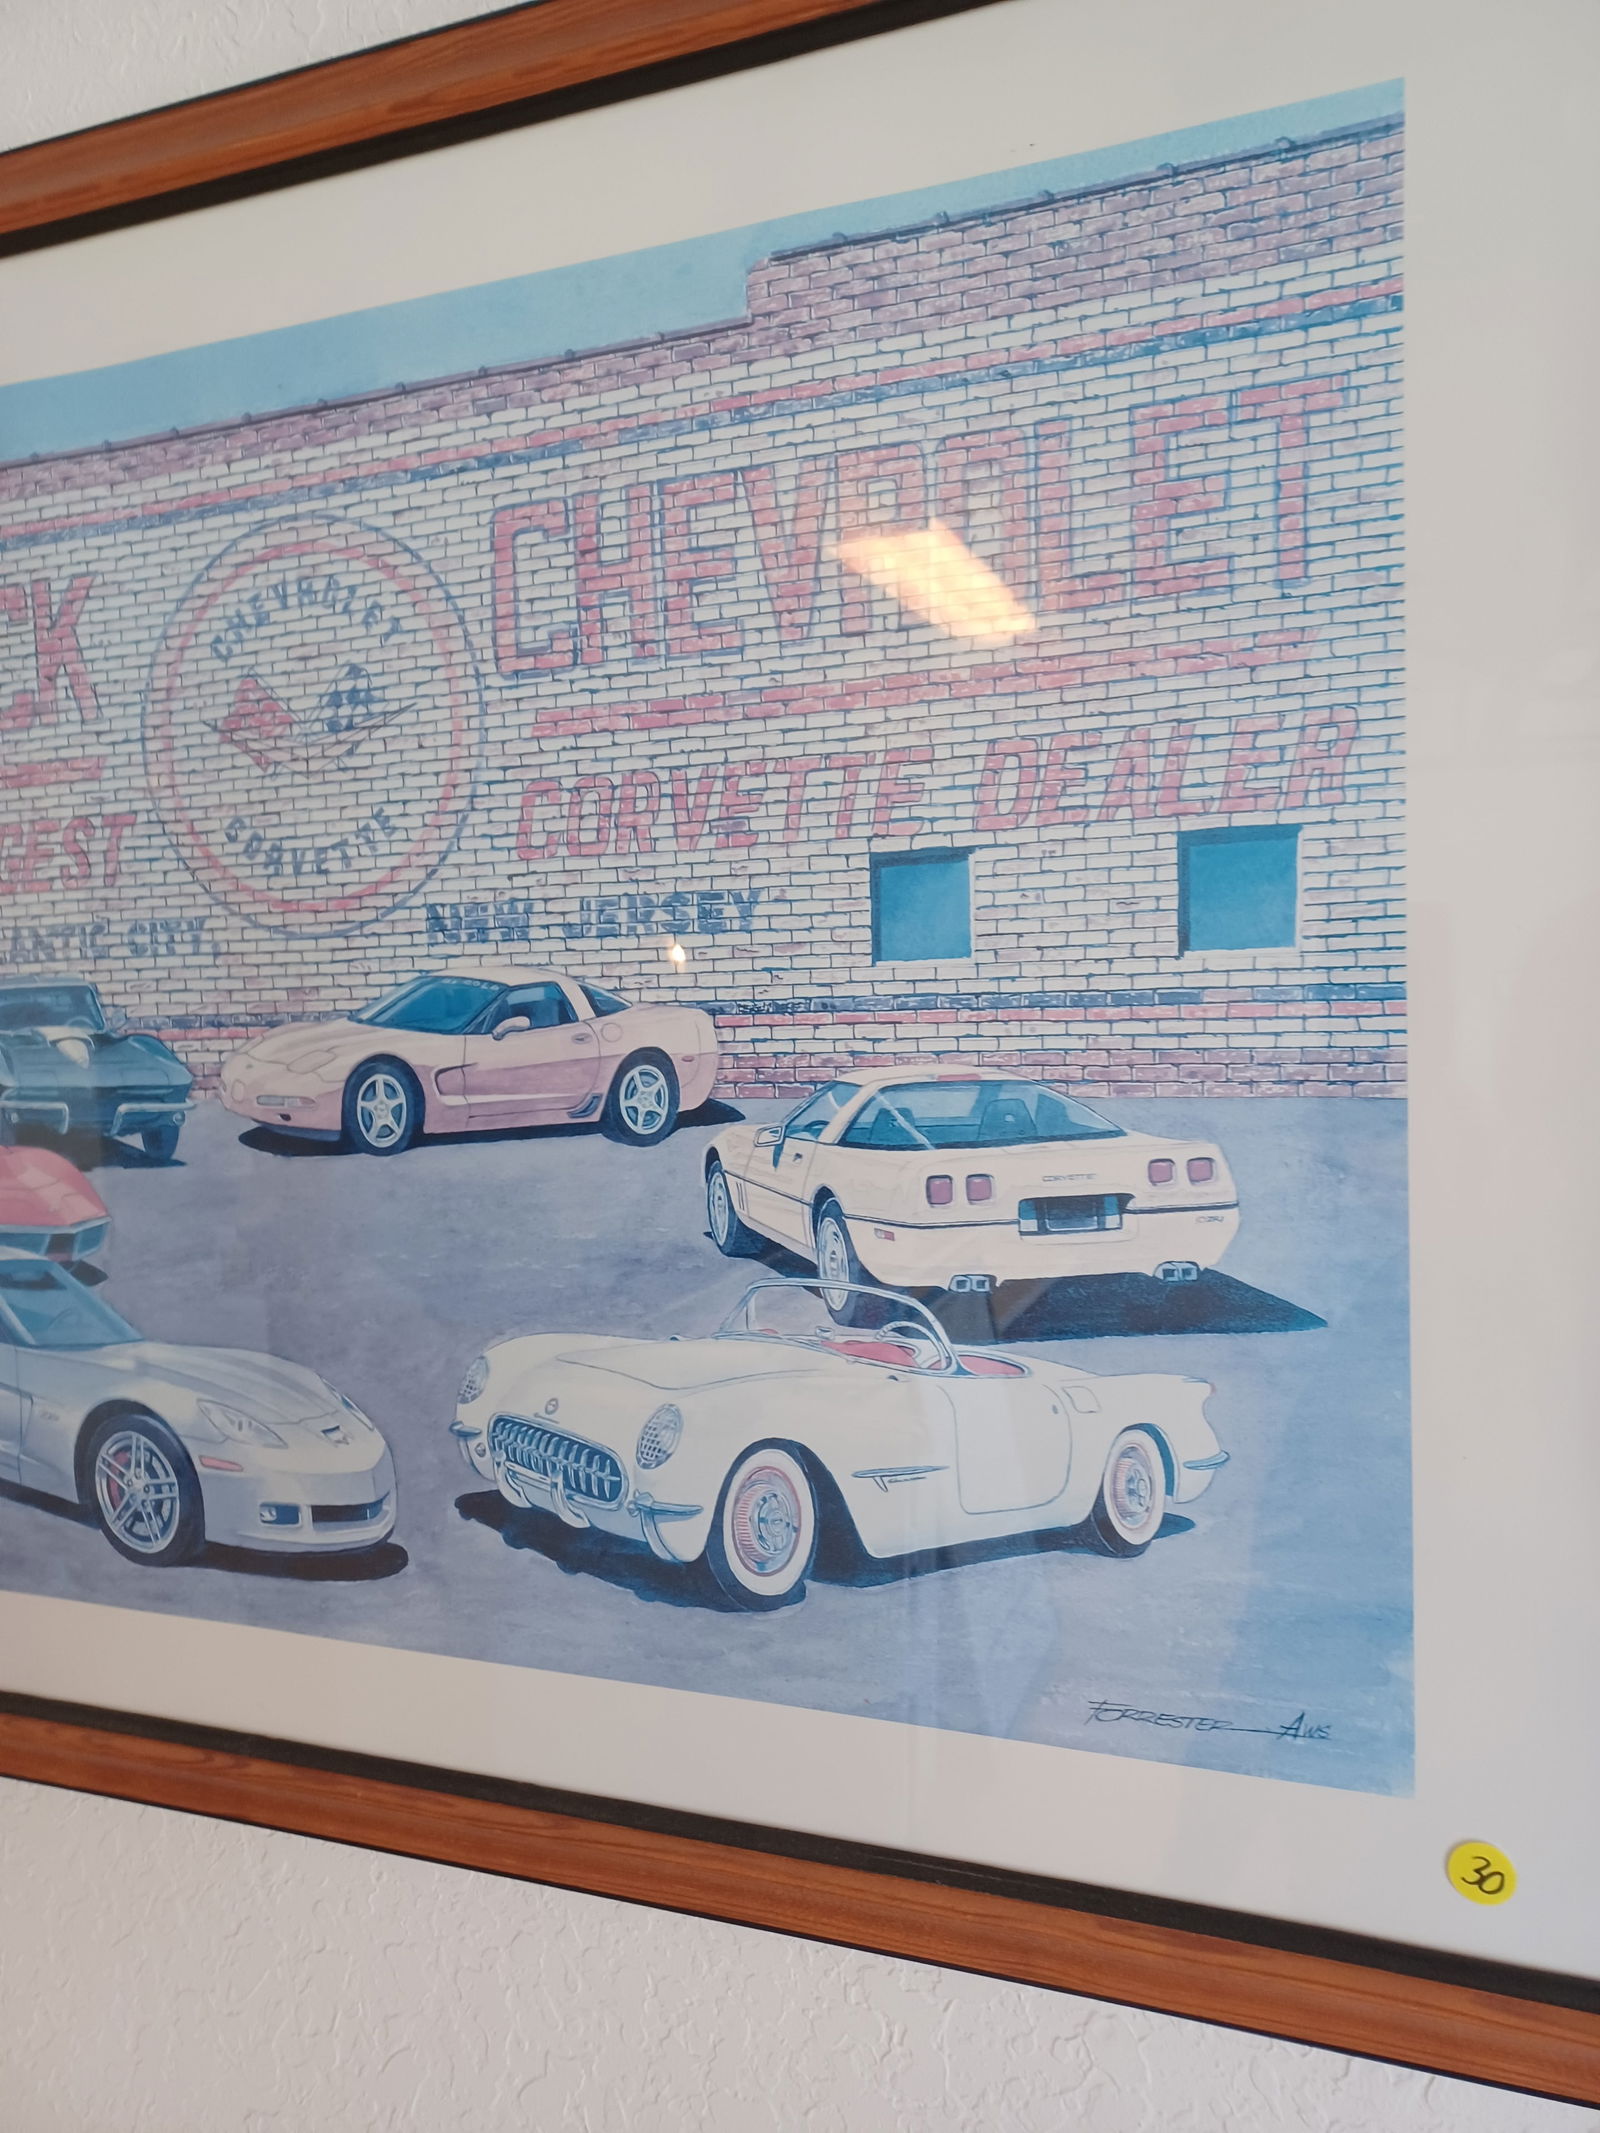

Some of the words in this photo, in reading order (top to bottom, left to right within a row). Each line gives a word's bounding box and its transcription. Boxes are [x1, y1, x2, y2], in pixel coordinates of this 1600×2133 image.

[489, 374, 1352, 680] CHEVROLET
[211, 577, 402, 661] CHEVROLET
[516, 746, 936, 861] CORVETTE
[973, 706, 1360, 831] DEALER
[225, 806, 398, 877] CORVETTE
[0, 921, 109, 963] ANTIC
[425, 896, 535, 943] NEW
[562, 889, 766, 940] JERSEY
[1461, 1855, 1506, 1896] 30
